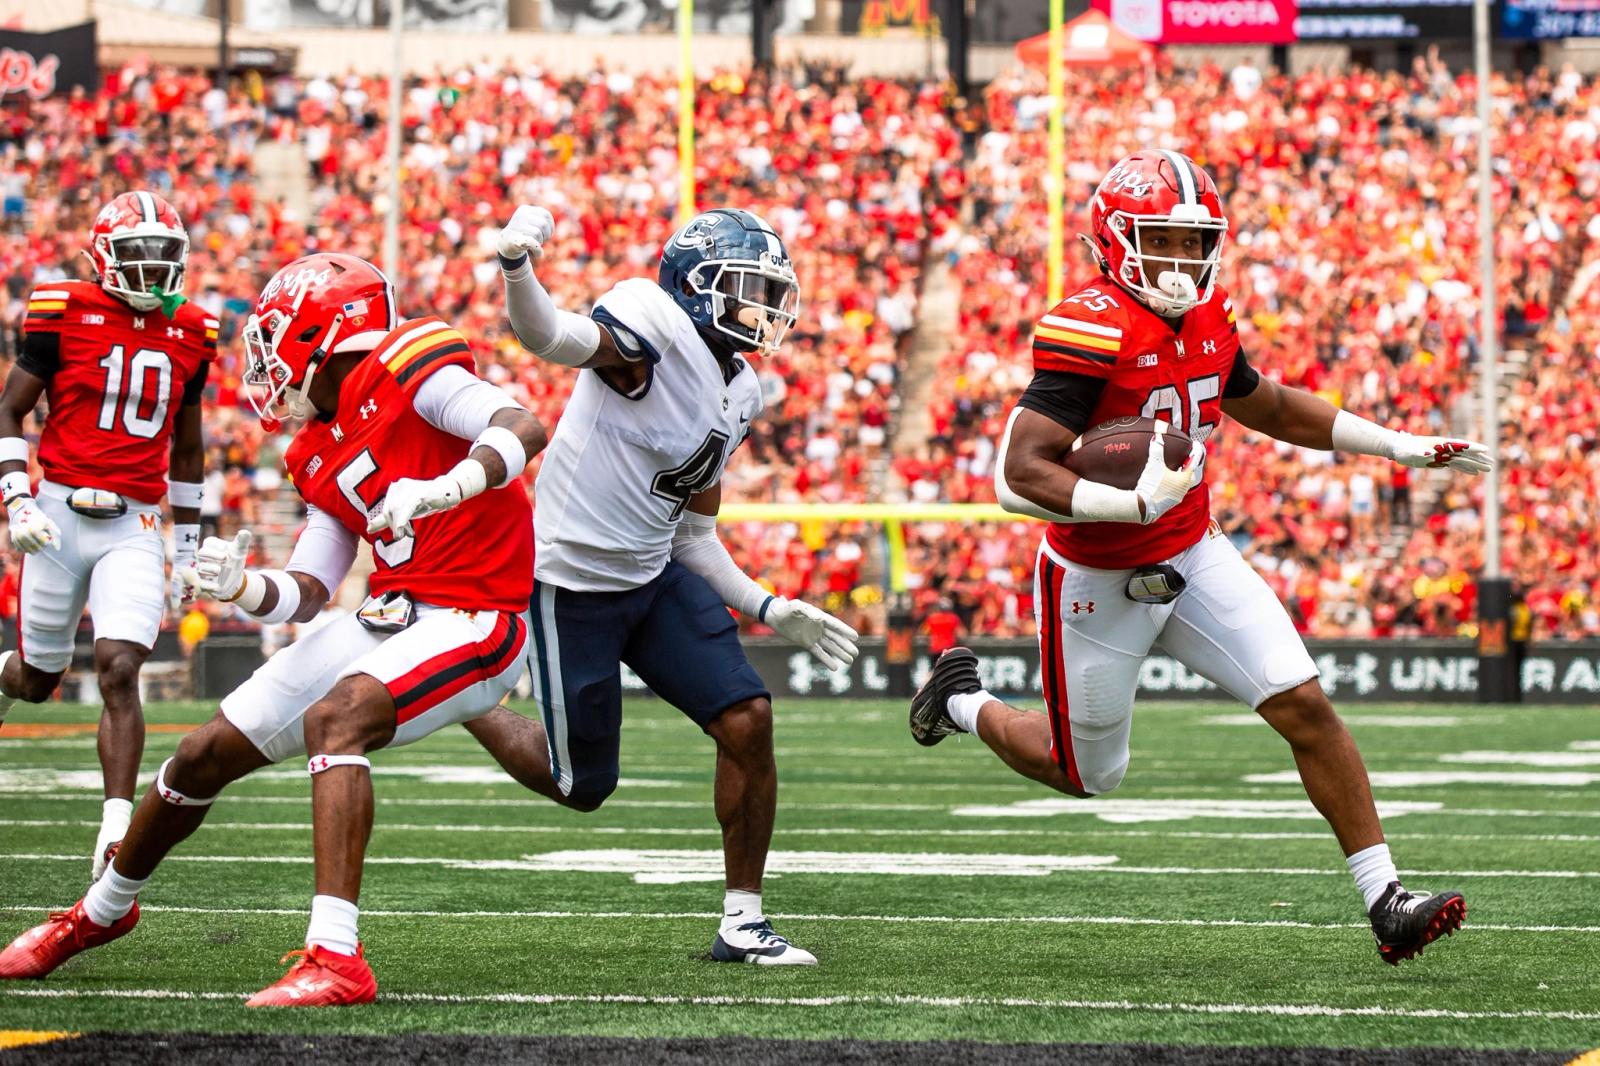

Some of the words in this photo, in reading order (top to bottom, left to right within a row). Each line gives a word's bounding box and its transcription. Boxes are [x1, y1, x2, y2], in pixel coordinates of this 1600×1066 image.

[1168, 1, 1280, 27] TOYOTA
[1064, 287, 1120, 313] 25
[96, 342, 173, 440] 10
[335, 443, 416, 569] 5
[650, 426, 750, 522] 4
